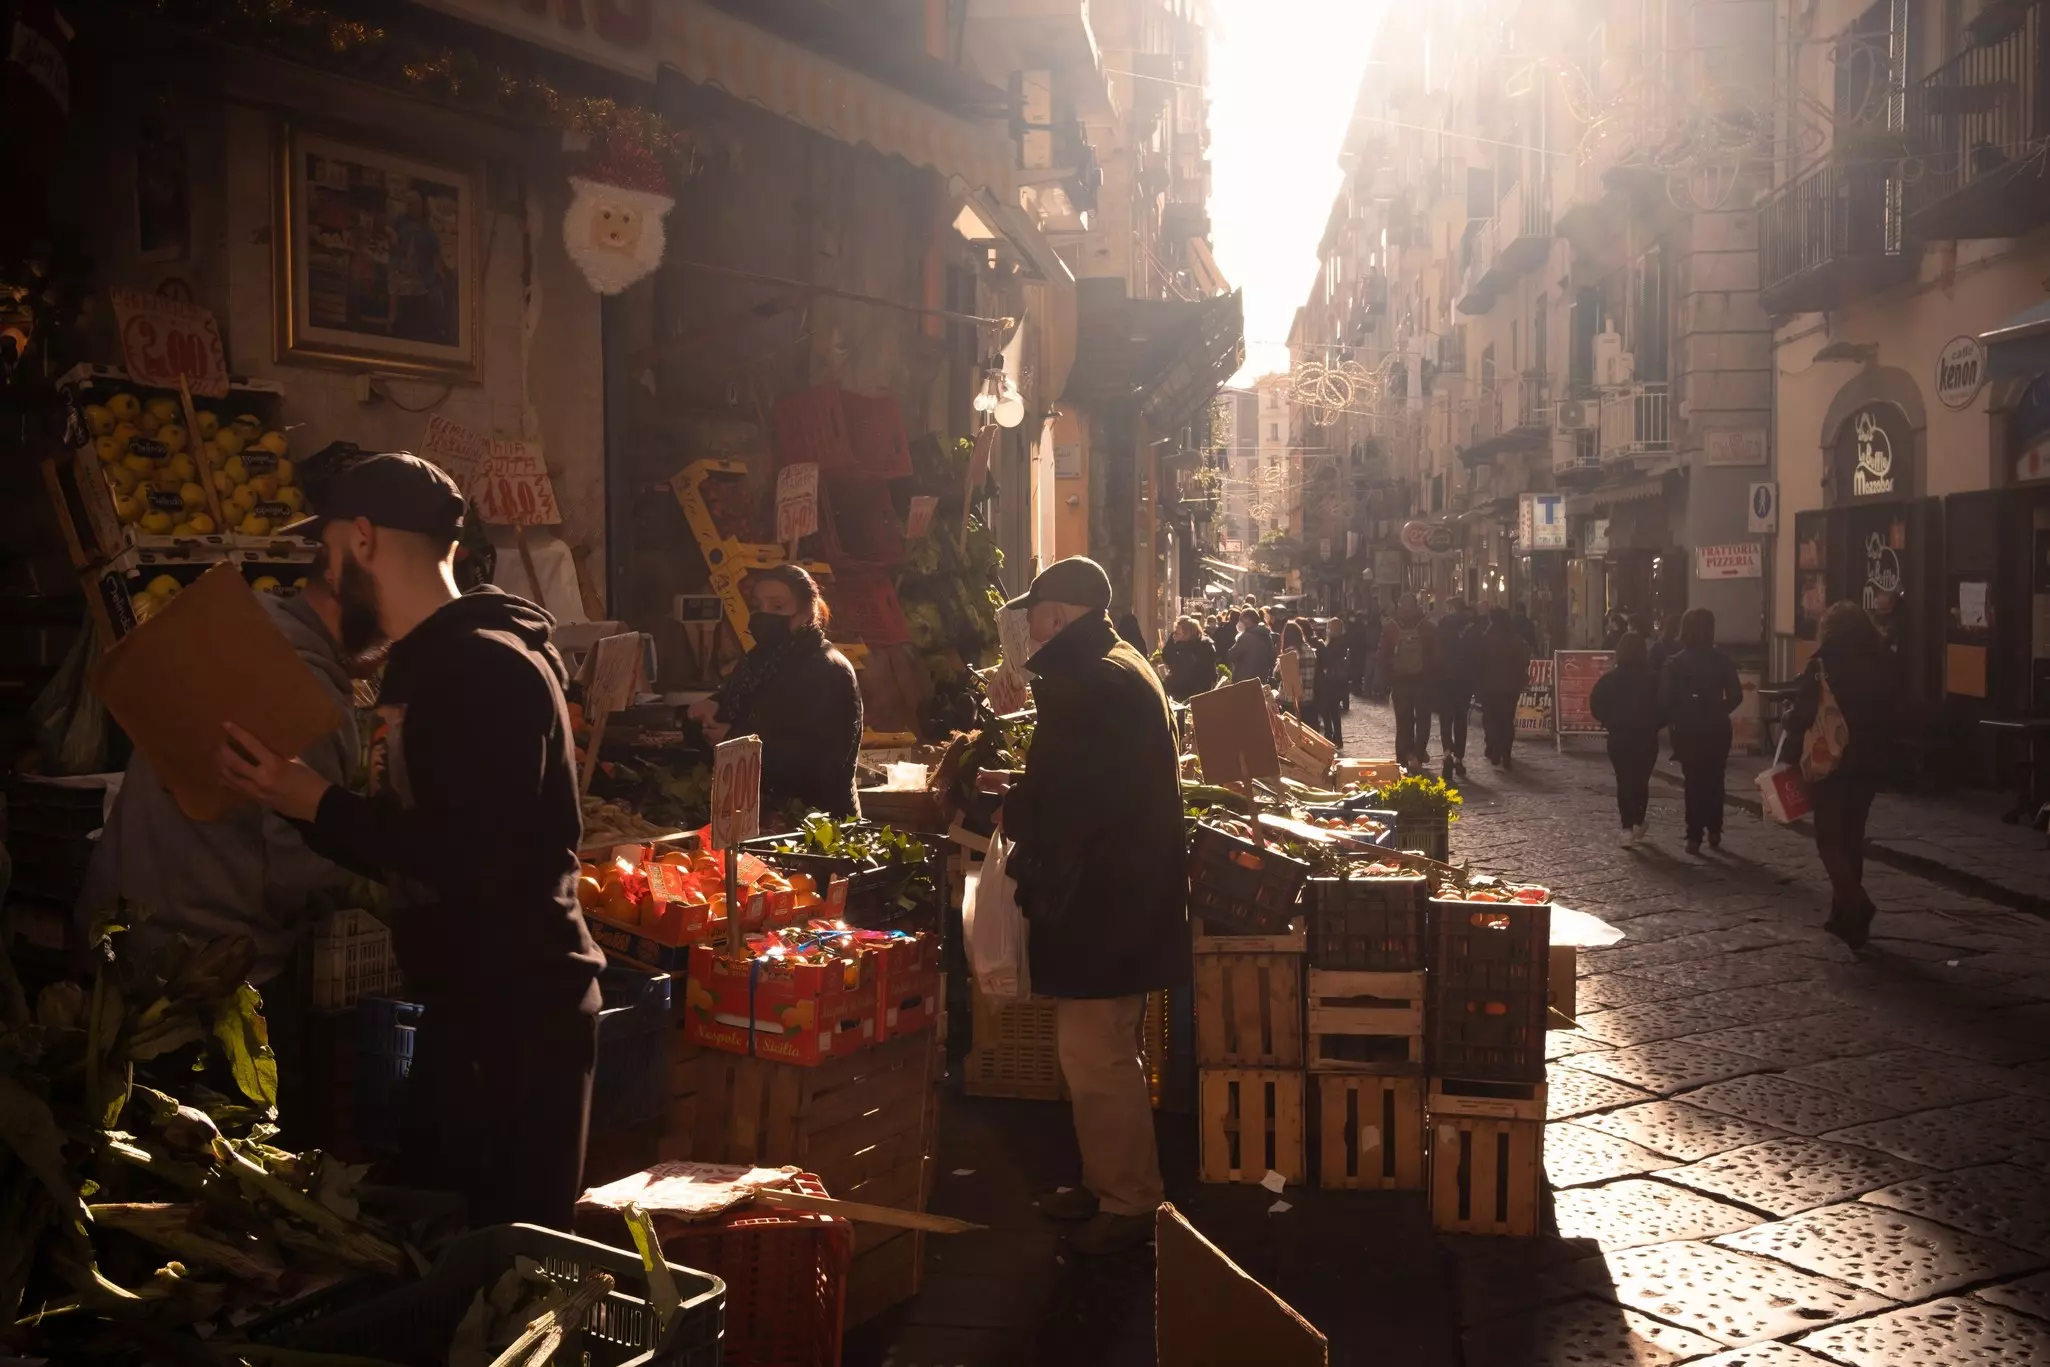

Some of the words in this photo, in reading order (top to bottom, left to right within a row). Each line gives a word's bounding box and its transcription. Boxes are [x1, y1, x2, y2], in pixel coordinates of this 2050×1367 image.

[1939, 358, 1977, 392] kenon
[1701, 544, 1759, 558] TRATTORIA
[1706, 555, 1754, 568] PIZZERIA
[697, 1024, 742, 1047] Nespole
[763, 1038, 800, 1057] Sicilia
